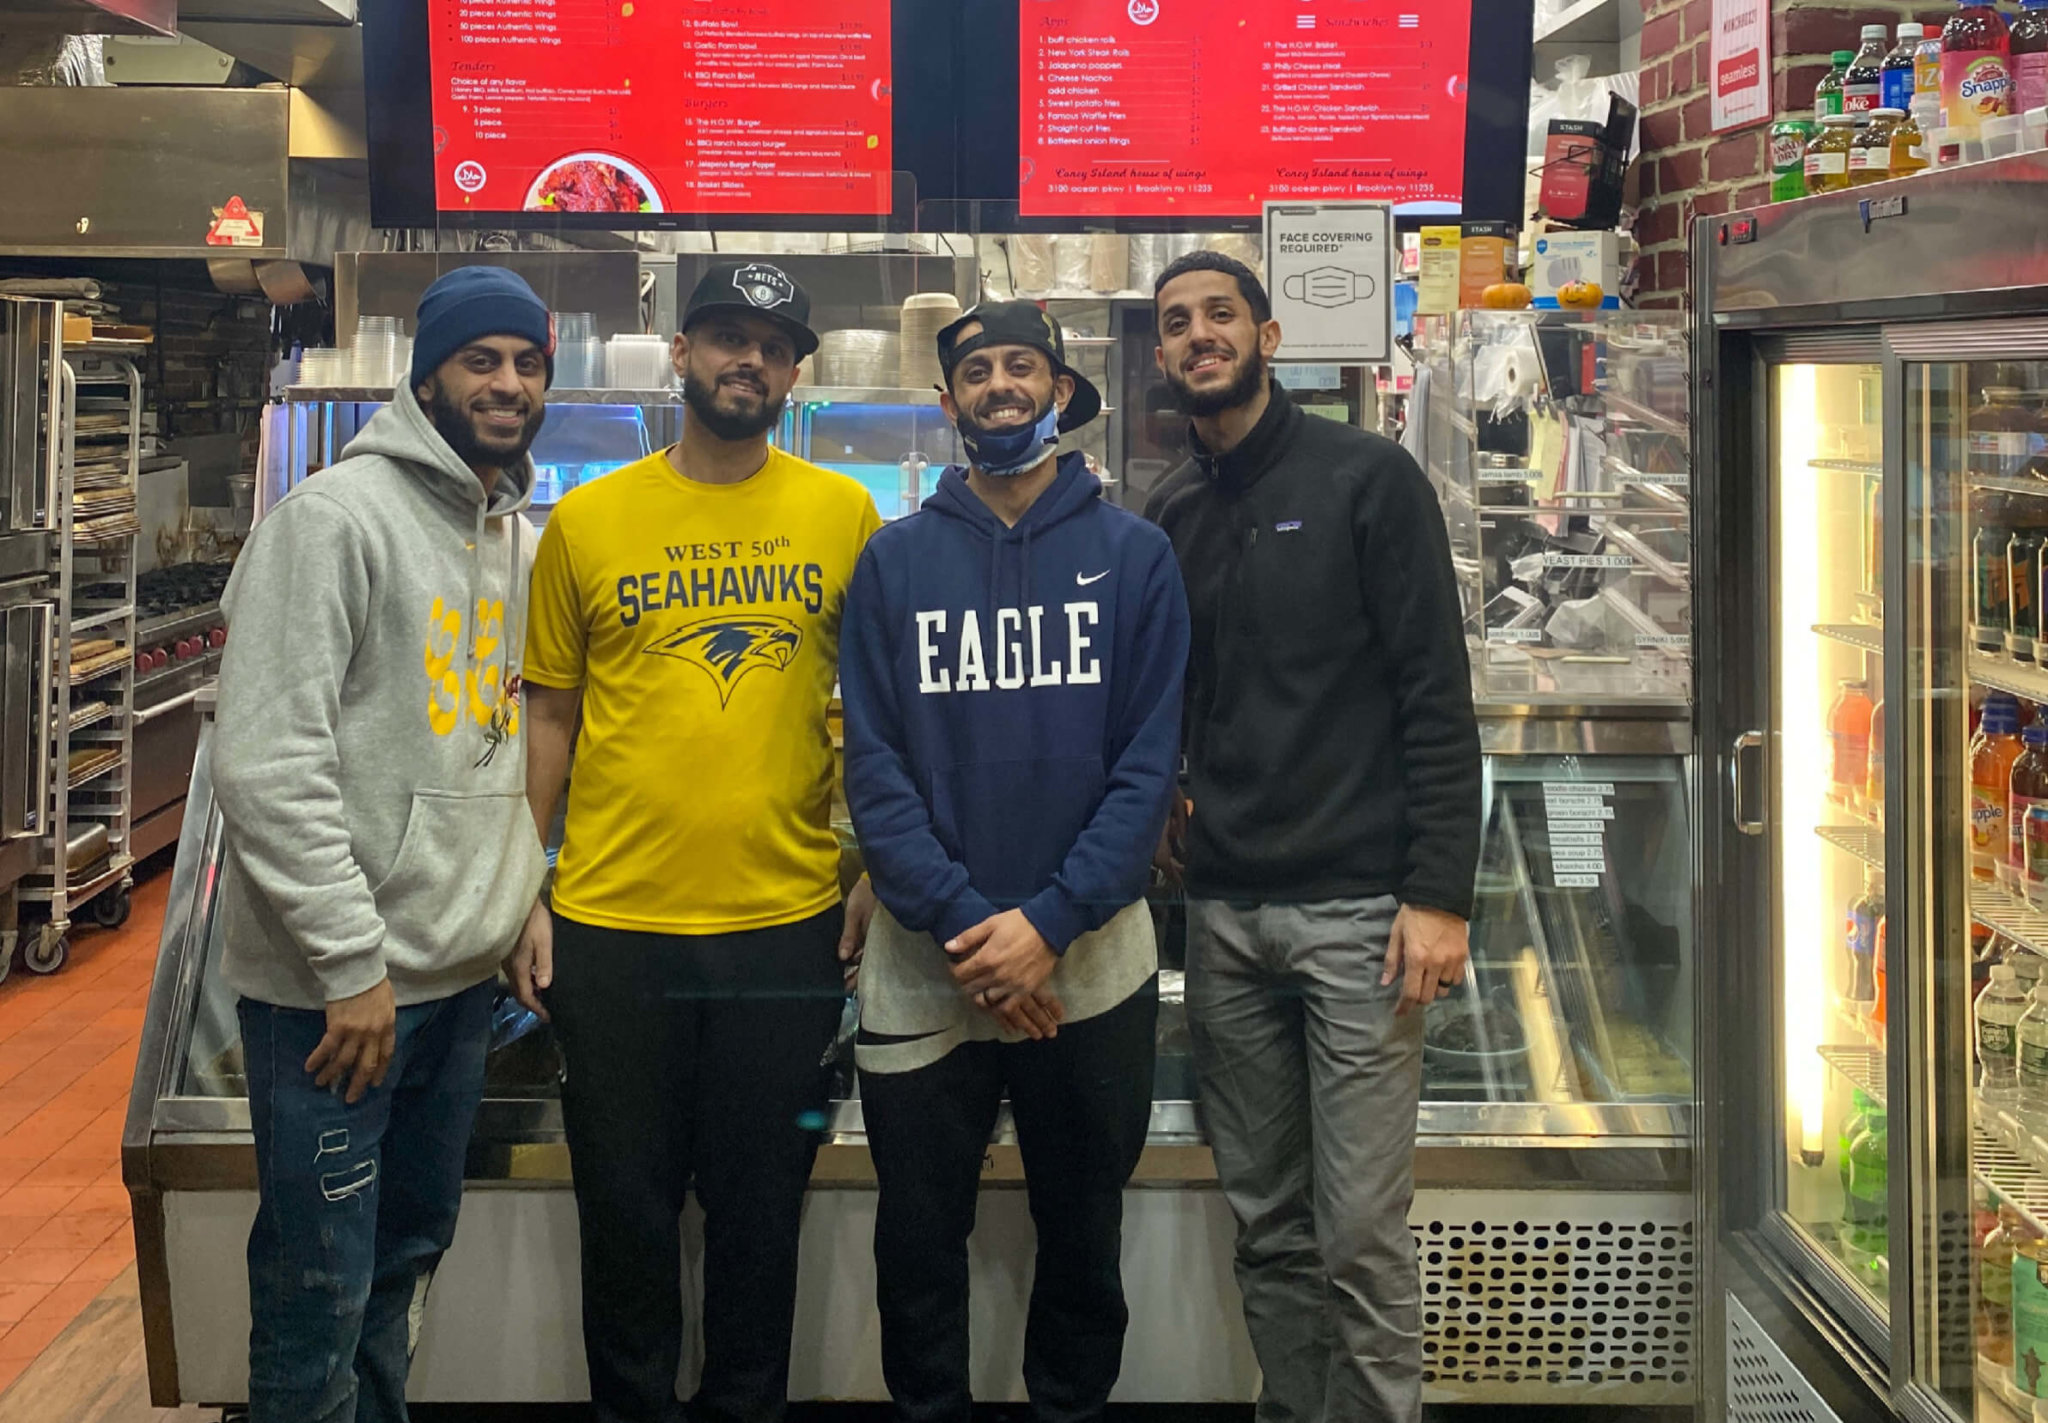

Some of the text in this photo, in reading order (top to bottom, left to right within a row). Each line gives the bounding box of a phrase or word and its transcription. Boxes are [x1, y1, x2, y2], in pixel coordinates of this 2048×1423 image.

[469, 10, 495, 19] pieces
[496, 10, 533, 18] Authentic
[534, 10, 557, 20] Wings
[470, 23, 495, 32] pieces
[497, 23, 534, 31] Authentic
[534, 23, 557, 33] Wings
[693, 20, 720, 28] Buffalo
[721, 20, 738, 28] Bowl
[474, 36, 500, 44] pieces
[501, 36, 538, 44] Authentic
[540, 36, 561, 46] Wings
[1066, 35, 1099, 44] chicken
[693, 41, 717, 50] Garlic
[718, 41, 738, 50] Parm
[1047, 48, 1067, 57] New
[1068, 48, 1086, 57] York
[1087, 48, 1110, 57] Steak
[451, 60, 496, 72] Tenders
[1088, 62, 1122, 71] poppers
[1273, 62, 1341, 72] Philly Cheese steak
[695, 71, 711, 79] BBQ
[711, 71, 736, 79] Ranch
[737, 71, 755, 79] Bowl
[1047, 74, 1113, 82] Cheese Nachos
[1720, 64, 1757, 86] seamless
[451, 77, 527, 88] Choice of any flavor
[1273, 83, 1365, 92] Grilled Chicken Sandwich
[1048, 86, 1099, 94] add chicken
[1047, 99, 1120, 109] Sweet potato fries
[1273, 104, 1286, 113] The
[1312, 104, 1342, 113] Chicken
[1343, 104, 1380, 113] Sandwich
[473, 105, 479, 114] 3
[480, 105, 502, 116] piece
[1047, 111, 1127, 120] Famous Waffle Fries
[480, 118, 503, 128] piece
[697, 118, 710, 126] The
[737, 119, 761, 128] Burger
[1047, 124, 1112, 134] Straight cut fries
[1271, 125, 1365, 134] Buffalo Chicken Sandwich
[475, 131, 507, 141] 10 piece
[697, 139, 712, 148] BBQ
[713, 140, 736, 148] ranch
[736, 140, 761, 148] bacon
[761, 140, 787, 149] burger
[1084, 137, 1108, 145] onion
[1109, 137, 1131, 147] Rings
[1777, 150, 1799, 163] DRY
[728, 160, 751, 170] Burger
[752, 160, 776, 170] Popper
[1056, 168, 1208, 182] Coney Island house of wings
[1276, 167, 1429, 181] Coney Island house of wings
[697, 181, 721, 189] Brisket
[722, 181, 745, 189] Sliders
[1047, 184, 1069, 193] 3100
[1071, 185, 1099, 193] ocean
[1101, 184, 1125, 194] pkwy
[1135, 184, 1172, 194] Brooklyn
[1174, 186, 1185, 194] ny
[1268, 184, 1290, 193] 3100
[1322, 184, 1346, 194] pkwy
[1356, 184, 1393, 194] Brooklyn
[1395, 186, 1407, 195] ny
[1471, 225, 1492, 233] STASH
[1280, 233, 1373, 242] FACE COVERING
[754, 272, 778, 286] NETS
[664, 536, 790, 562] WEST 50th
[1543, 556, 1575, 565] YEAST
[1579, 556, 1603, 566] PIES
[616, 563, 823, 627] SEAHAWKS
[916, 602, 1100, 694] EAGLE
